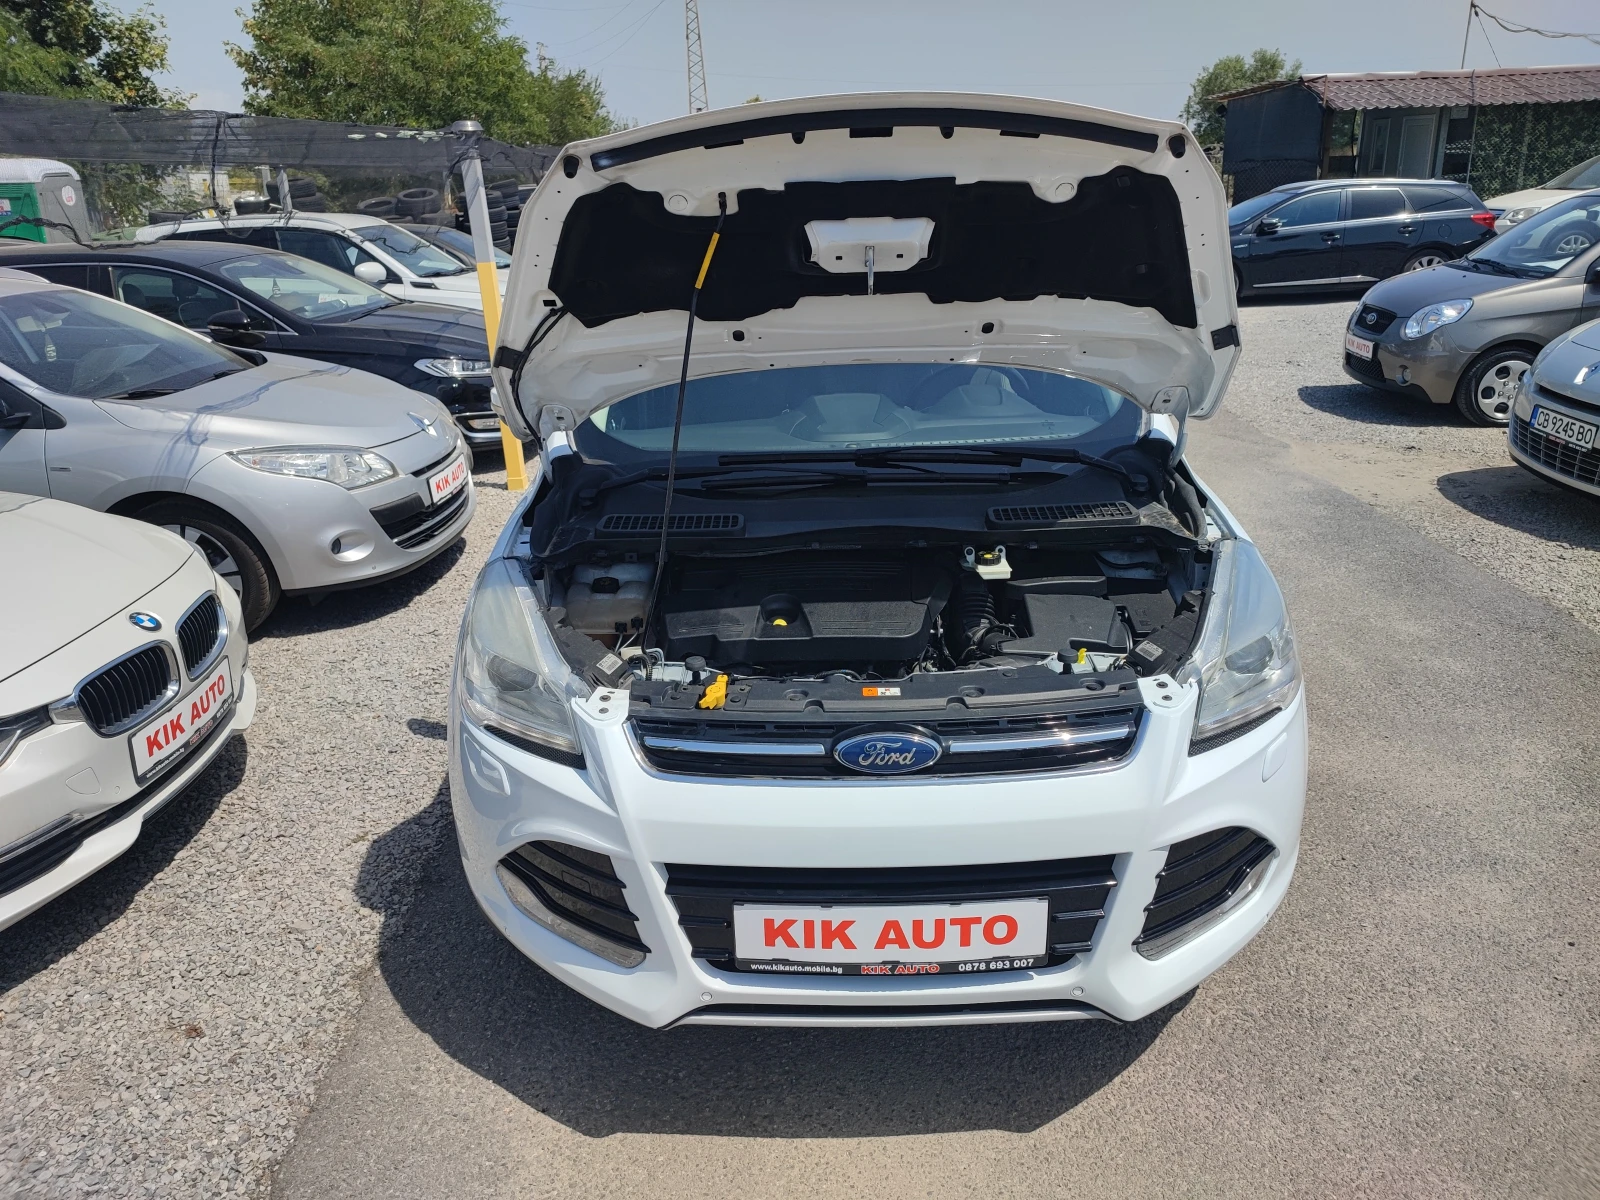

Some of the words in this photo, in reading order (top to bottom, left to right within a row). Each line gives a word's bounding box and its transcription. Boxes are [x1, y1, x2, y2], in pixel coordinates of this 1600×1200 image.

[1356, 341, 1370, 353] AUTO
[1537, 411, 1550, 428] CB
[1551, 416, 1576, 438] 9245
[1576, 425, 1593, 444] BO
[435, 474, 451, 494] KIK
[451, 461, 464, 483] AUTO
[146, 712, 186, 758] KIK
[191, 674, 225, 726] AUTO
[858, 741, 917, 766] Ford
[763, 918, 858, 950] KIK
[873, 914, 1019, 950] AUTO
[750, 963, 843, 974] www.kikauto.mobile.bg
[860, 965, 892, 975] KIK
[894, 963, 940, 975] AUTO
[958, 962, 987, 972] 0878
[989, 960, 1011, 970] 693
[1013, 958, 1035, 968] 007
